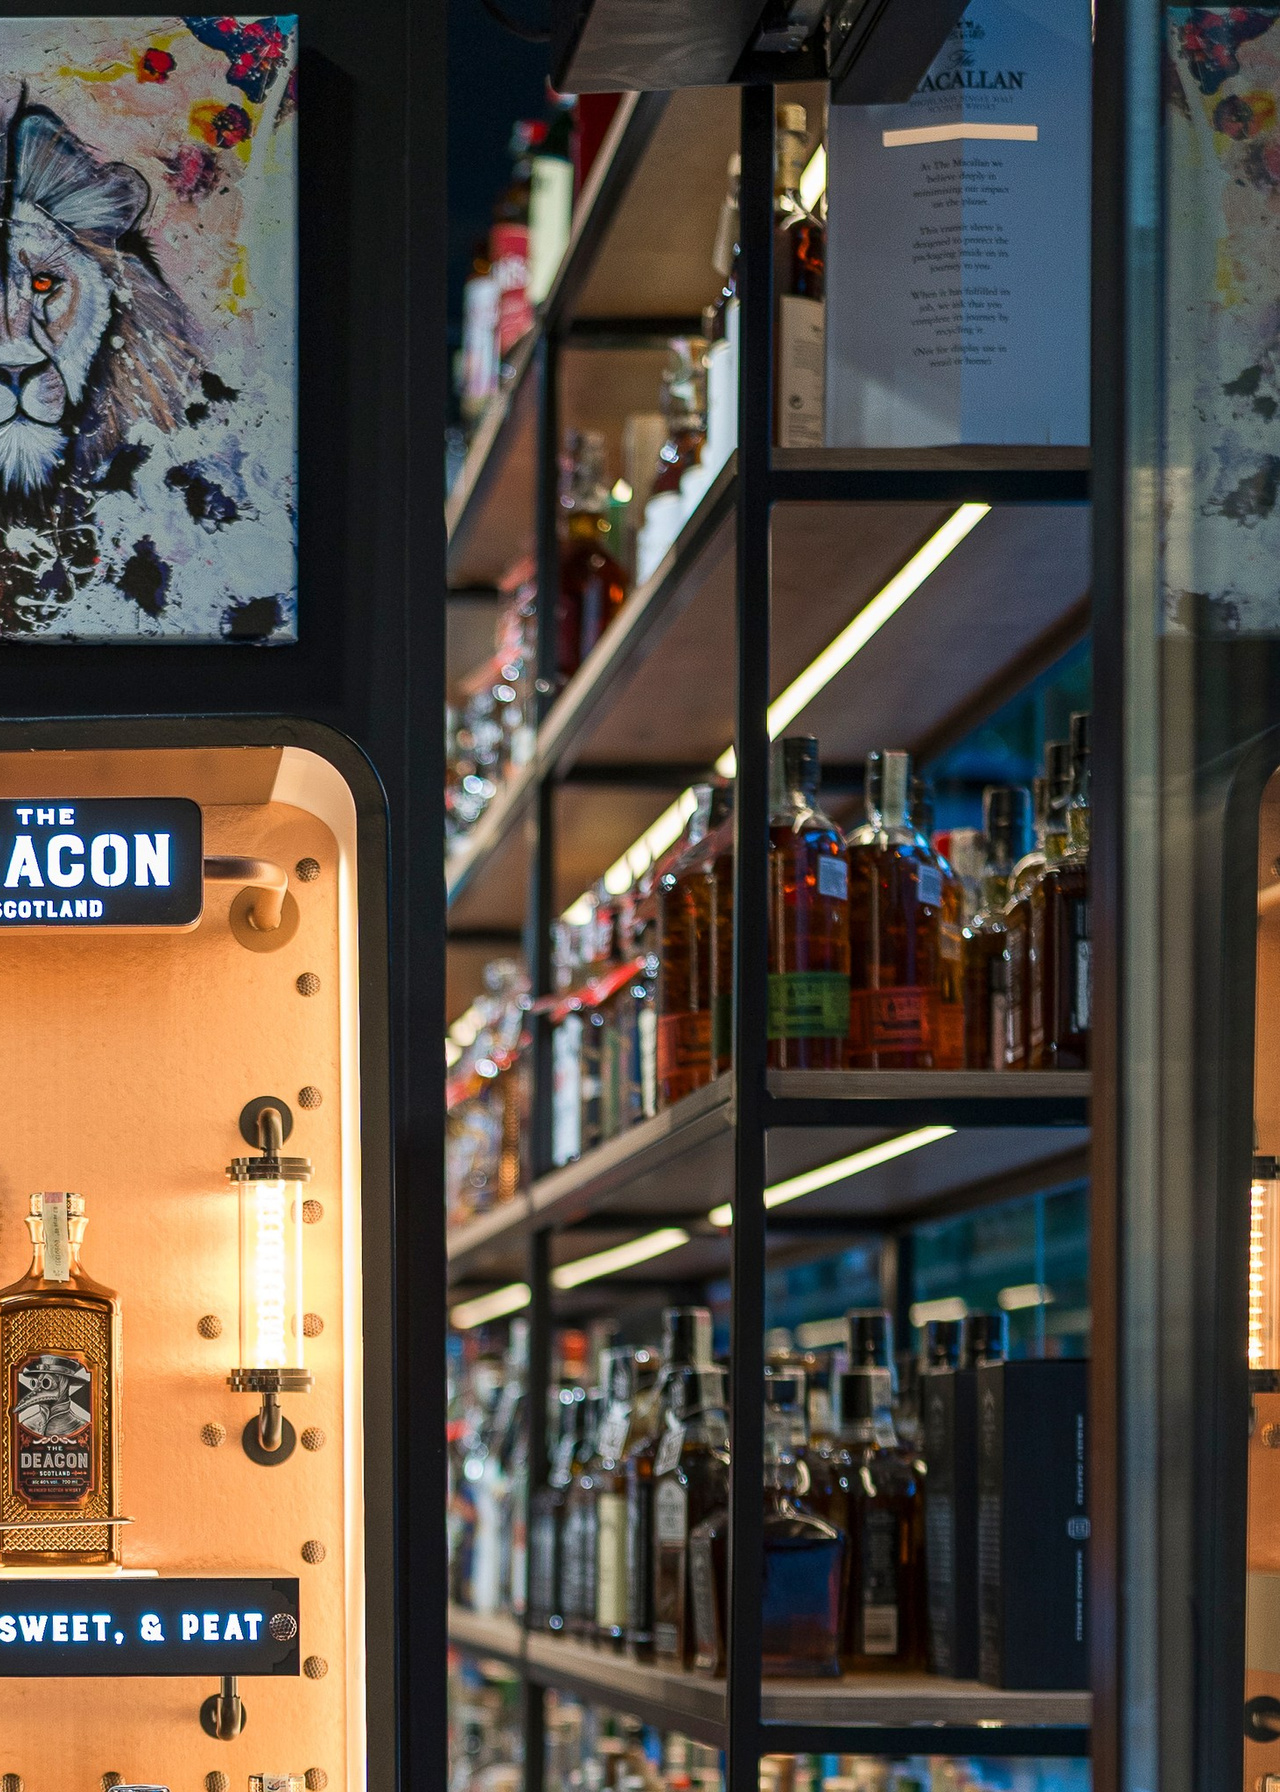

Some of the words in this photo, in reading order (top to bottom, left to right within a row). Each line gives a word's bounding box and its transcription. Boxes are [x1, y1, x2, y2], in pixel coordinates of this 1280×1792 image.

[16, 808, 75, 826] THE
[21, 1453, 89, 1468] DEACON
[140, 1613, 165, 1642] &
[181, 1613, 263, 1641] PEAT
